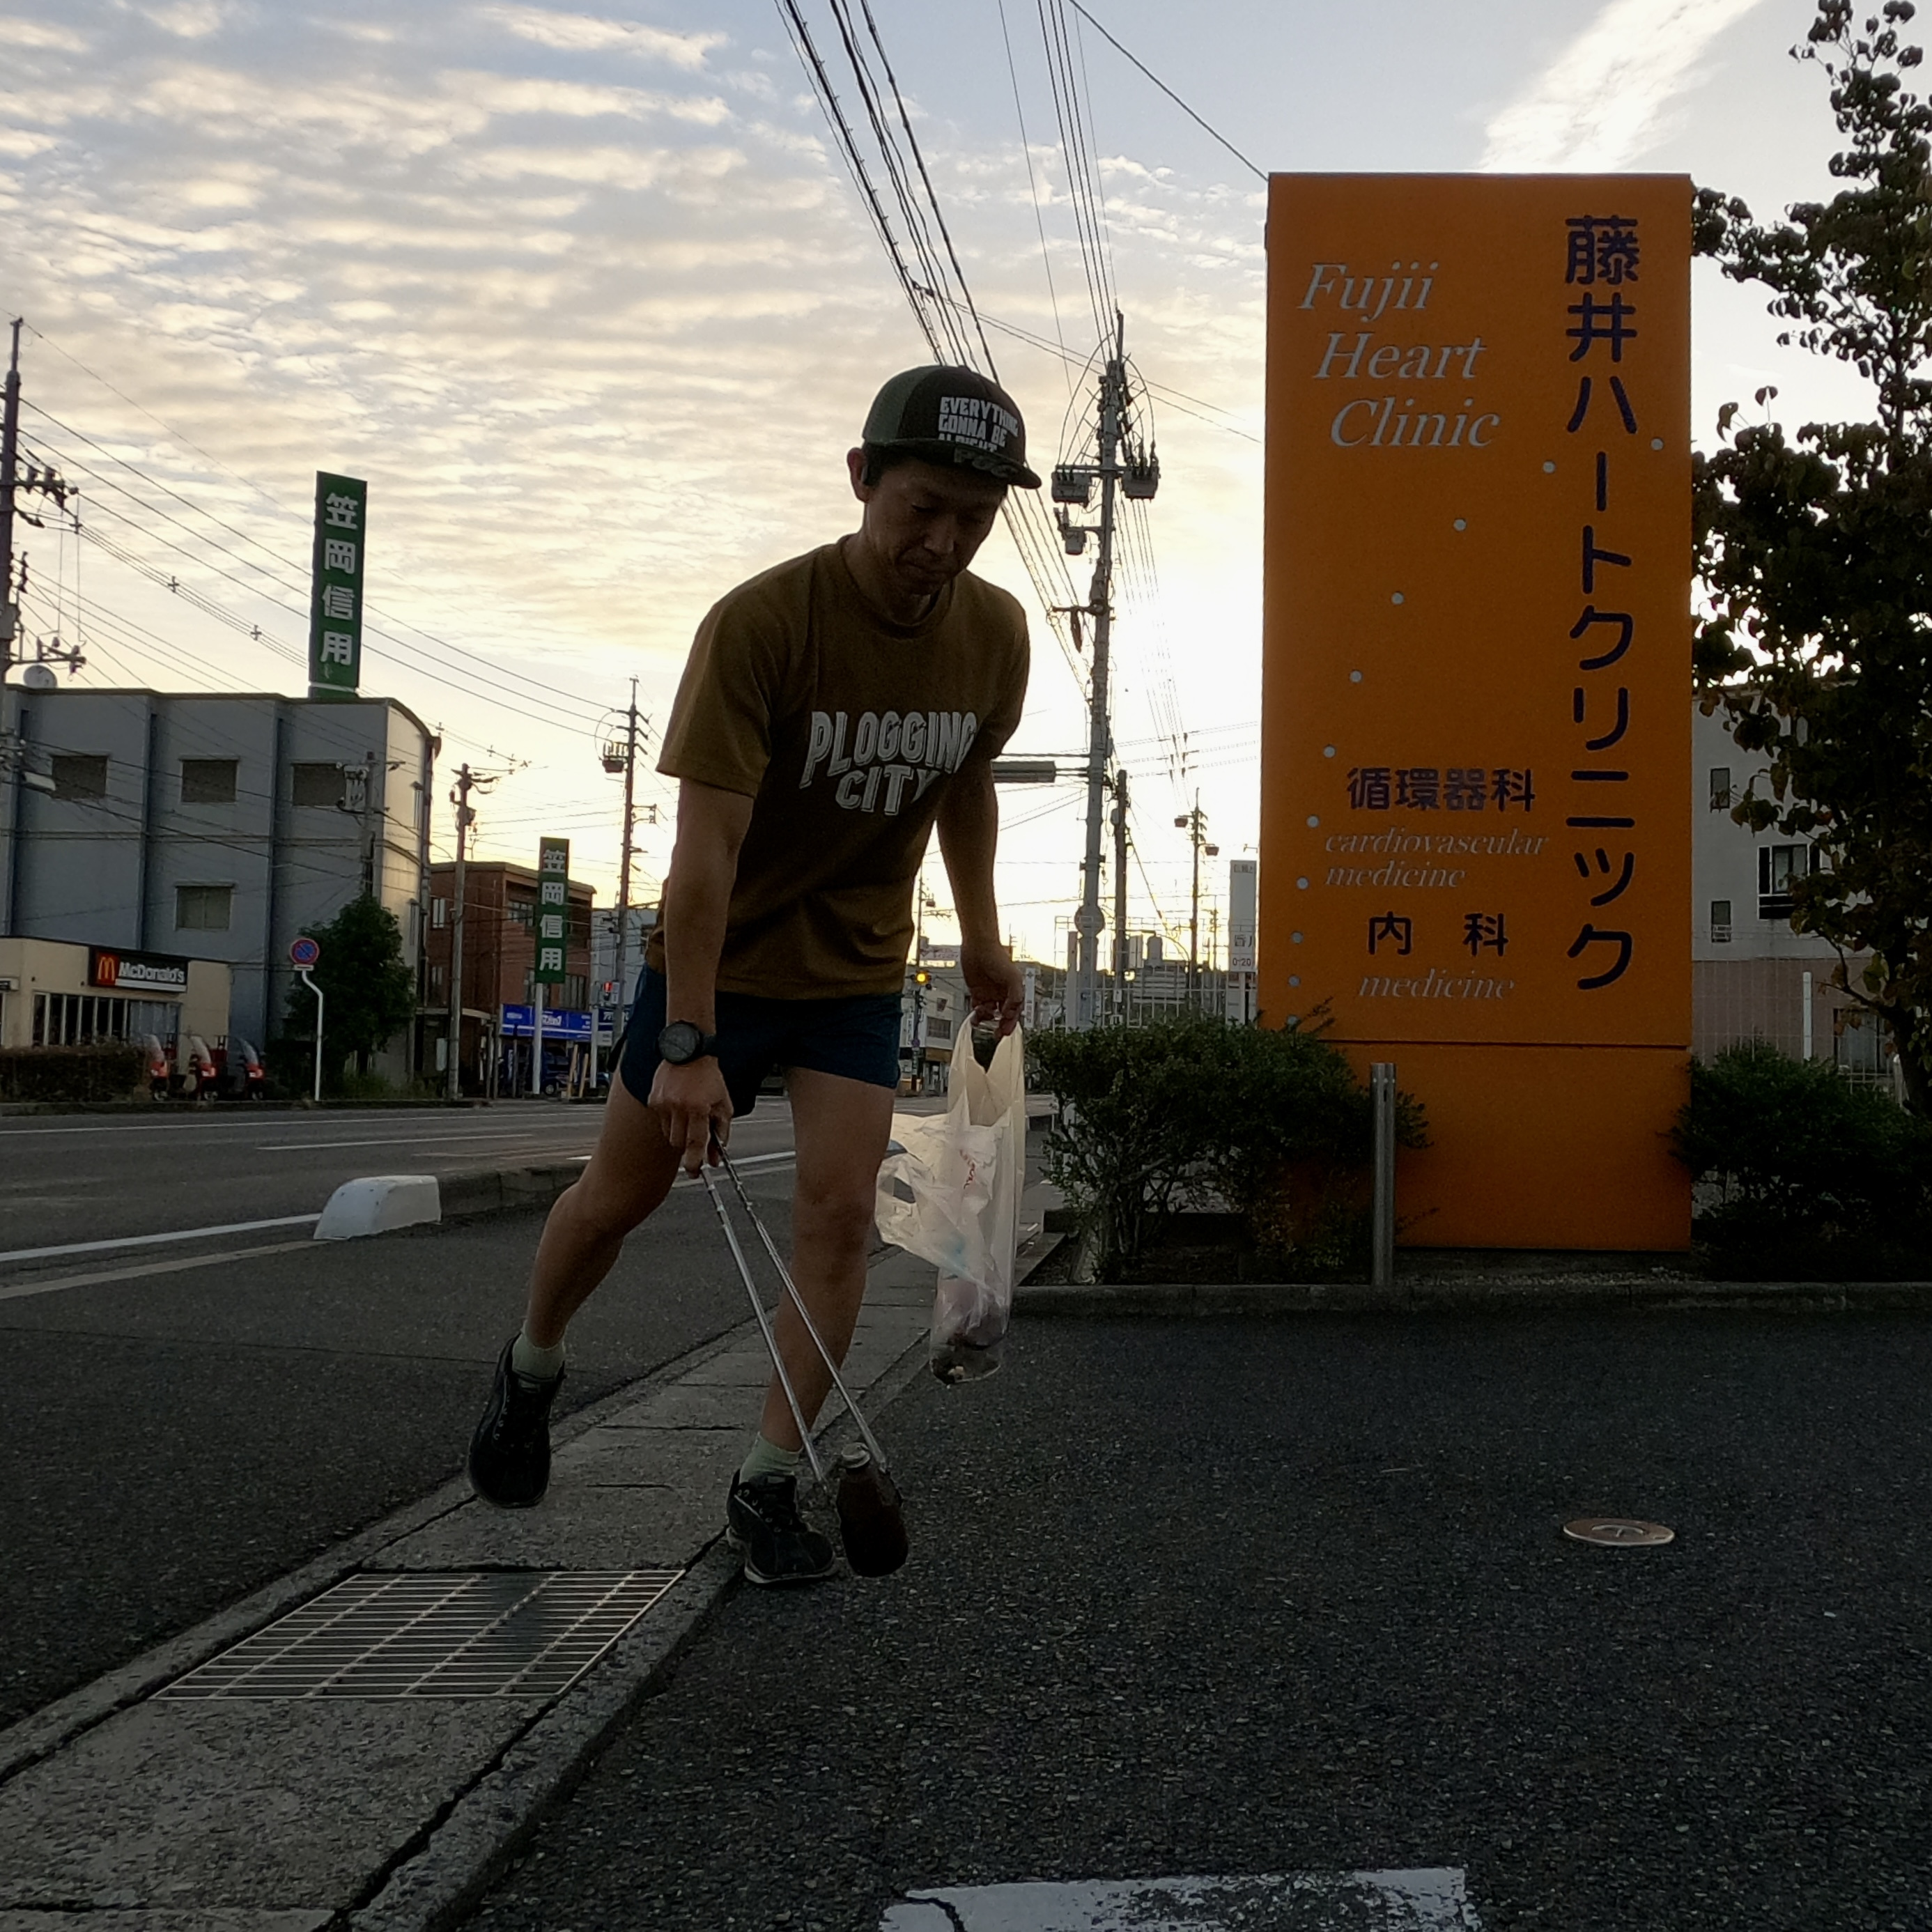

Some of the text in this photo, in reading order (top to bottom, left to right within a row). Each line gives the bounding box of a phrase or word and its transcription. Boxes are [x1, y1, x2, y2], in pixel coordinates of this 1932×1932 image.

[1297, 261, 1439, 323] Fujii
[1313, 332, 1487, 379] Heart
[938, 414, 1007, 447] GONNA BE
[1329, 397, 1500, 447] Clinic
[320, 492, 358, 665] 笠岡信用
[1565, 215, 1639, 989] 藤井ハートクリニック
[835, 764, 941, 815] CITY
[1347, 767, 1535, 812] 循環器科
[1324, 827, 1549, 856] cardiovascular
[1324, 861, 1466, 888] medicine
[539, 849, 566, 971] 笠岡信用
[118, 961, 185, 983] McDonald's
[1359, 969, 1515, 999] medicine
